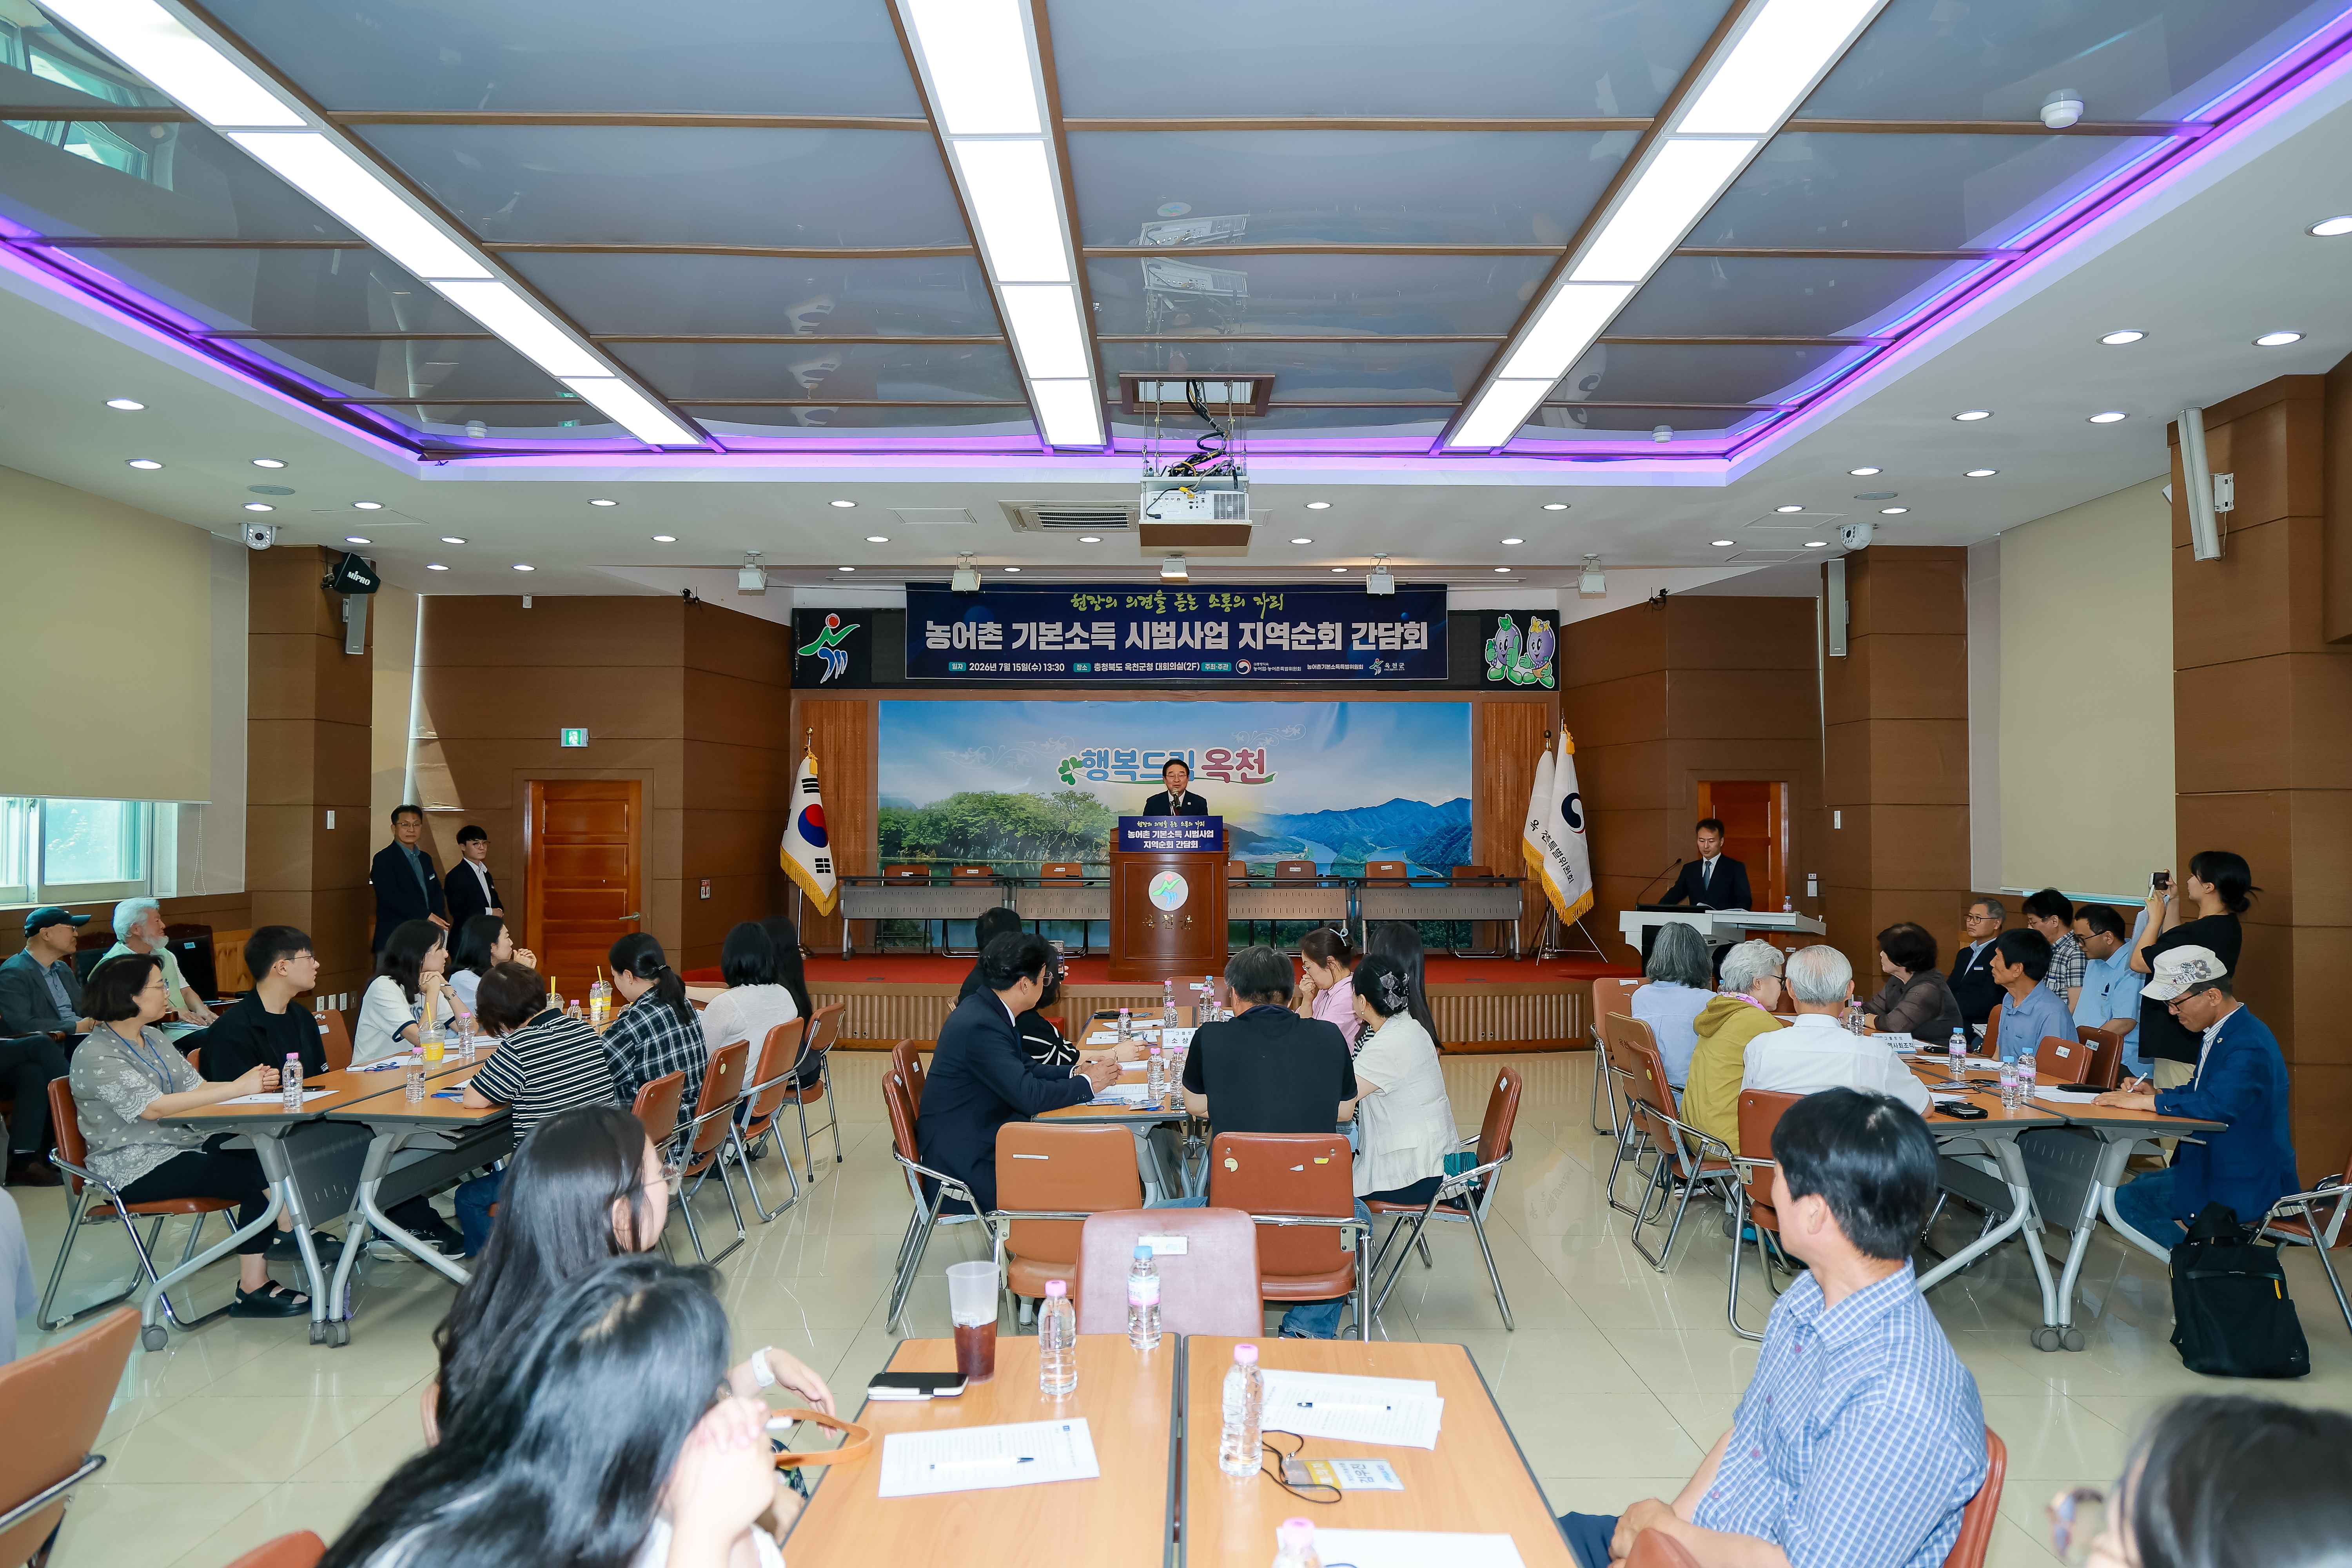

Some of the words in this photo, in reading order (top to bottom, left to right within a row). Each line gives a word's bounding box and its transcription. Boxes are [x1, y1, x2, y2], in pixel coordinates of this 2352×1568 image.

[1071, 593, 1117, 611] 현장의
[1126, 590, 1167, 613] 의견을
[1174, 592, 1199, 612] 듣는
[1209, 593, 1245, 612] 소통의
[1253, 592, 1283, 619] 자리
[926, 621, 1003, 650] 농어촌
[1012, 621, 1116, 650] 기본소득
[1125, 621, 1229, 650] 시범사업
[1239, 622, 1342, 650] 지역순회
[1352, 621, 1428, 650] 간담회
[969, 662, 997, 671] 2026년
[998, 662, 1011, 671] 7월
[1013, 662, 1042, 672] 15일(수)
[1094, 663, 1123, 671] 충청북도
[1125, 662, 1153, 671] 옥천군청
[1155, 662, 1200, 671] 대회의실(2F)
[1201, 749, 1266, 783] 옥천
[1154, 820, 1168, 828] 의견을
[1195, 820, 1205, 829] 자리
[1127, 830, 1150, 838] 농어촌
[1152, 830, 1182, 838] 기본소득
[1184, 830, 1214, 838] 시범사업
[1143, 840, 1174, 849] 지역순회
[1176, 840, 1198, 849] 간담회
